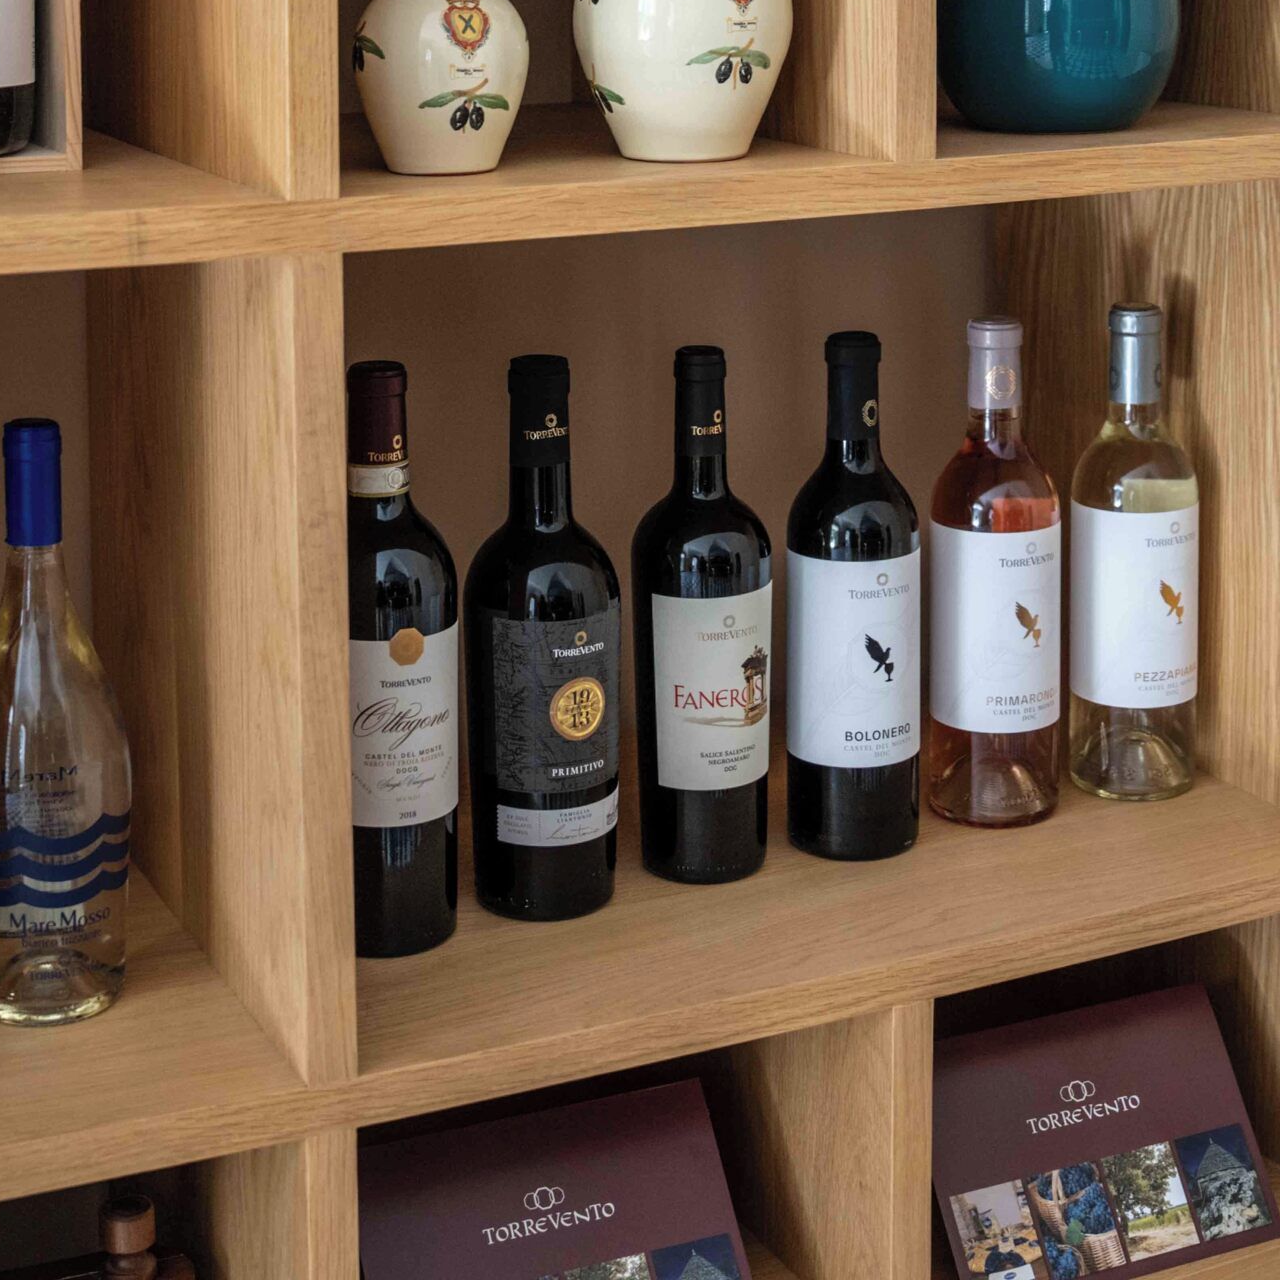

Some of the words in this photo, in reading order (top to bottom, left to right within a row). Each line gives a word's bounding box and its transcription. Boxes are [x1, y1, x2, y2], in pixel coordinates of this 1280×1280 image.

[572, 688, 590, 704] 19
[673, 676, 763, 710] FANEROS
[572, 711, 590, 729] 13
[845, 723, 911, 742] BOLONERO
[365, 752, 397, 760] CASTEL
[401, 751, 416, 759] DEL
[419, 744, 442, 756] MONTE
[700, 751, 722, 759] SALICE
[552, 759, 605, 777] PRIMITIVO
[399, 811, 417, 820] 2018
[10, 912, 56, 938] Mare
[59, 908, 111, 933] Mosso
[1026, 1094, 1141, 1135] TORREVENTO
[482, 1202, 615, 1245] TORREVENTO
